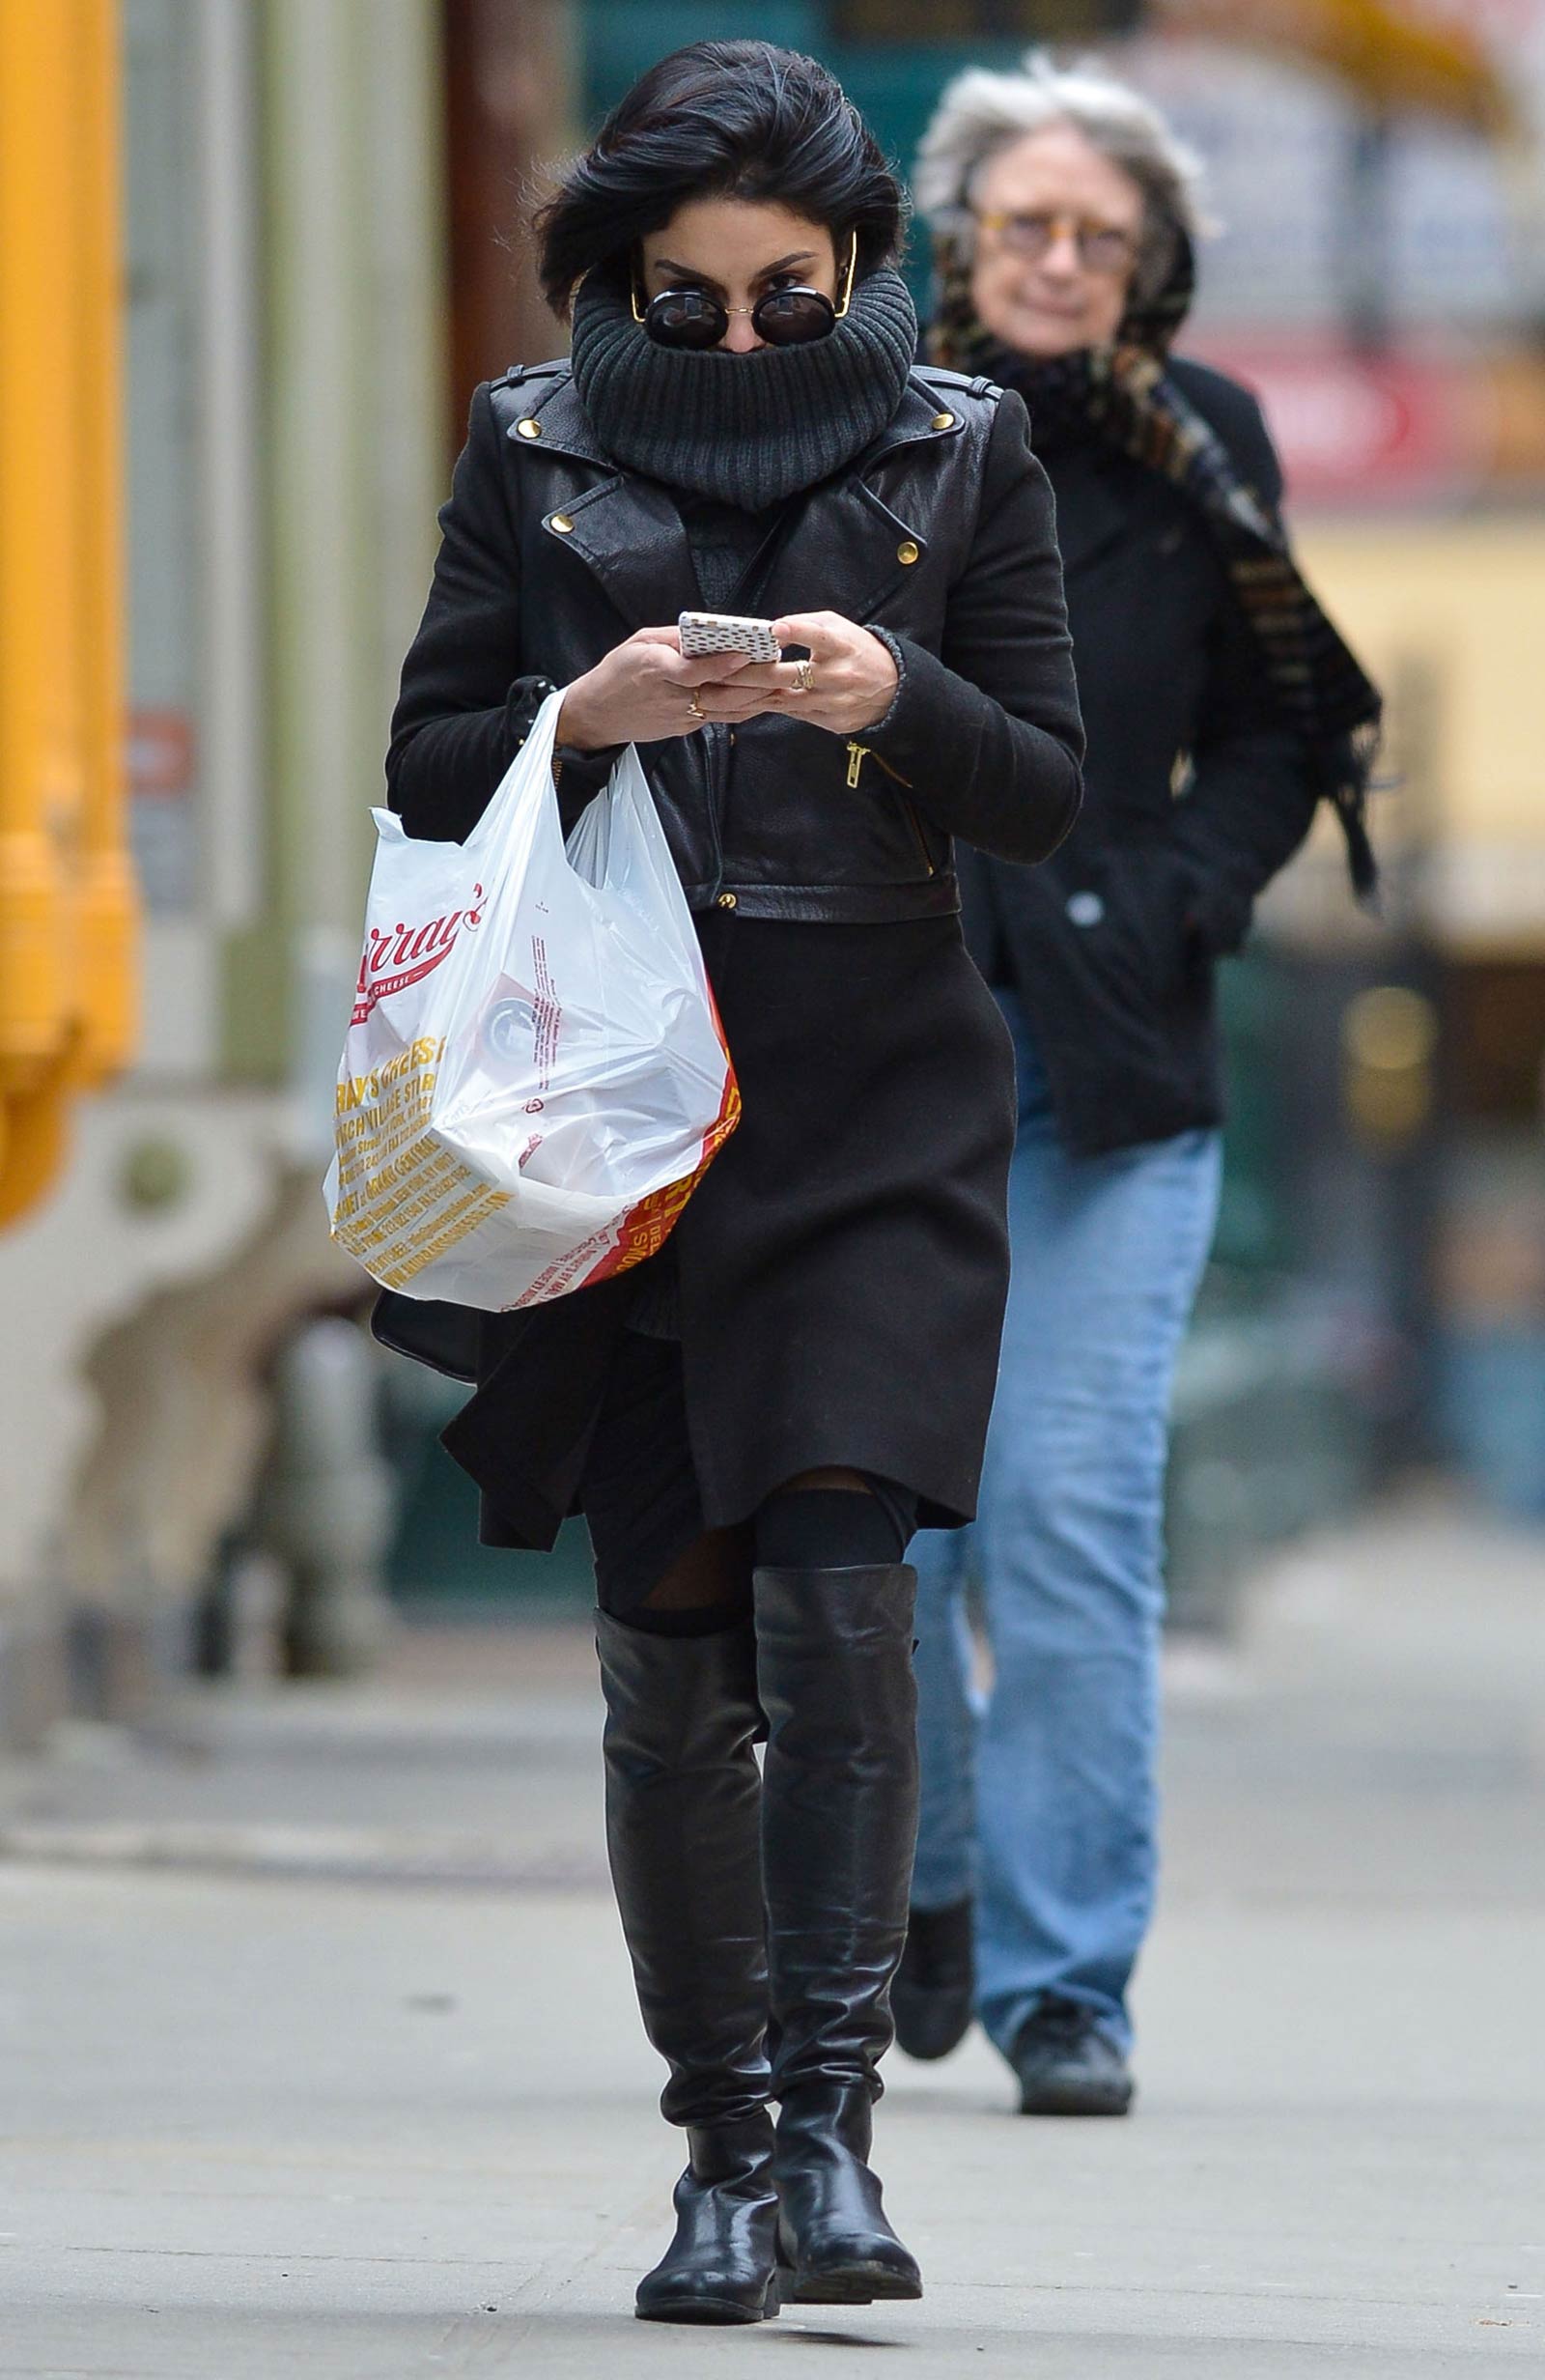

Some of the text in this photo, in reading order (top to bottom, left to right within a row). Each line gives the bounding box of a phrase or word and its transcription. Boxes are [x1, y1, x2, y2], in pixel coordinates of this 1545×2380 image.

[356, 883, 488, 993] rray's
[373, 975, 410, 996] CHEESE
[393, 1134, 442, 1176] CENTRAL
